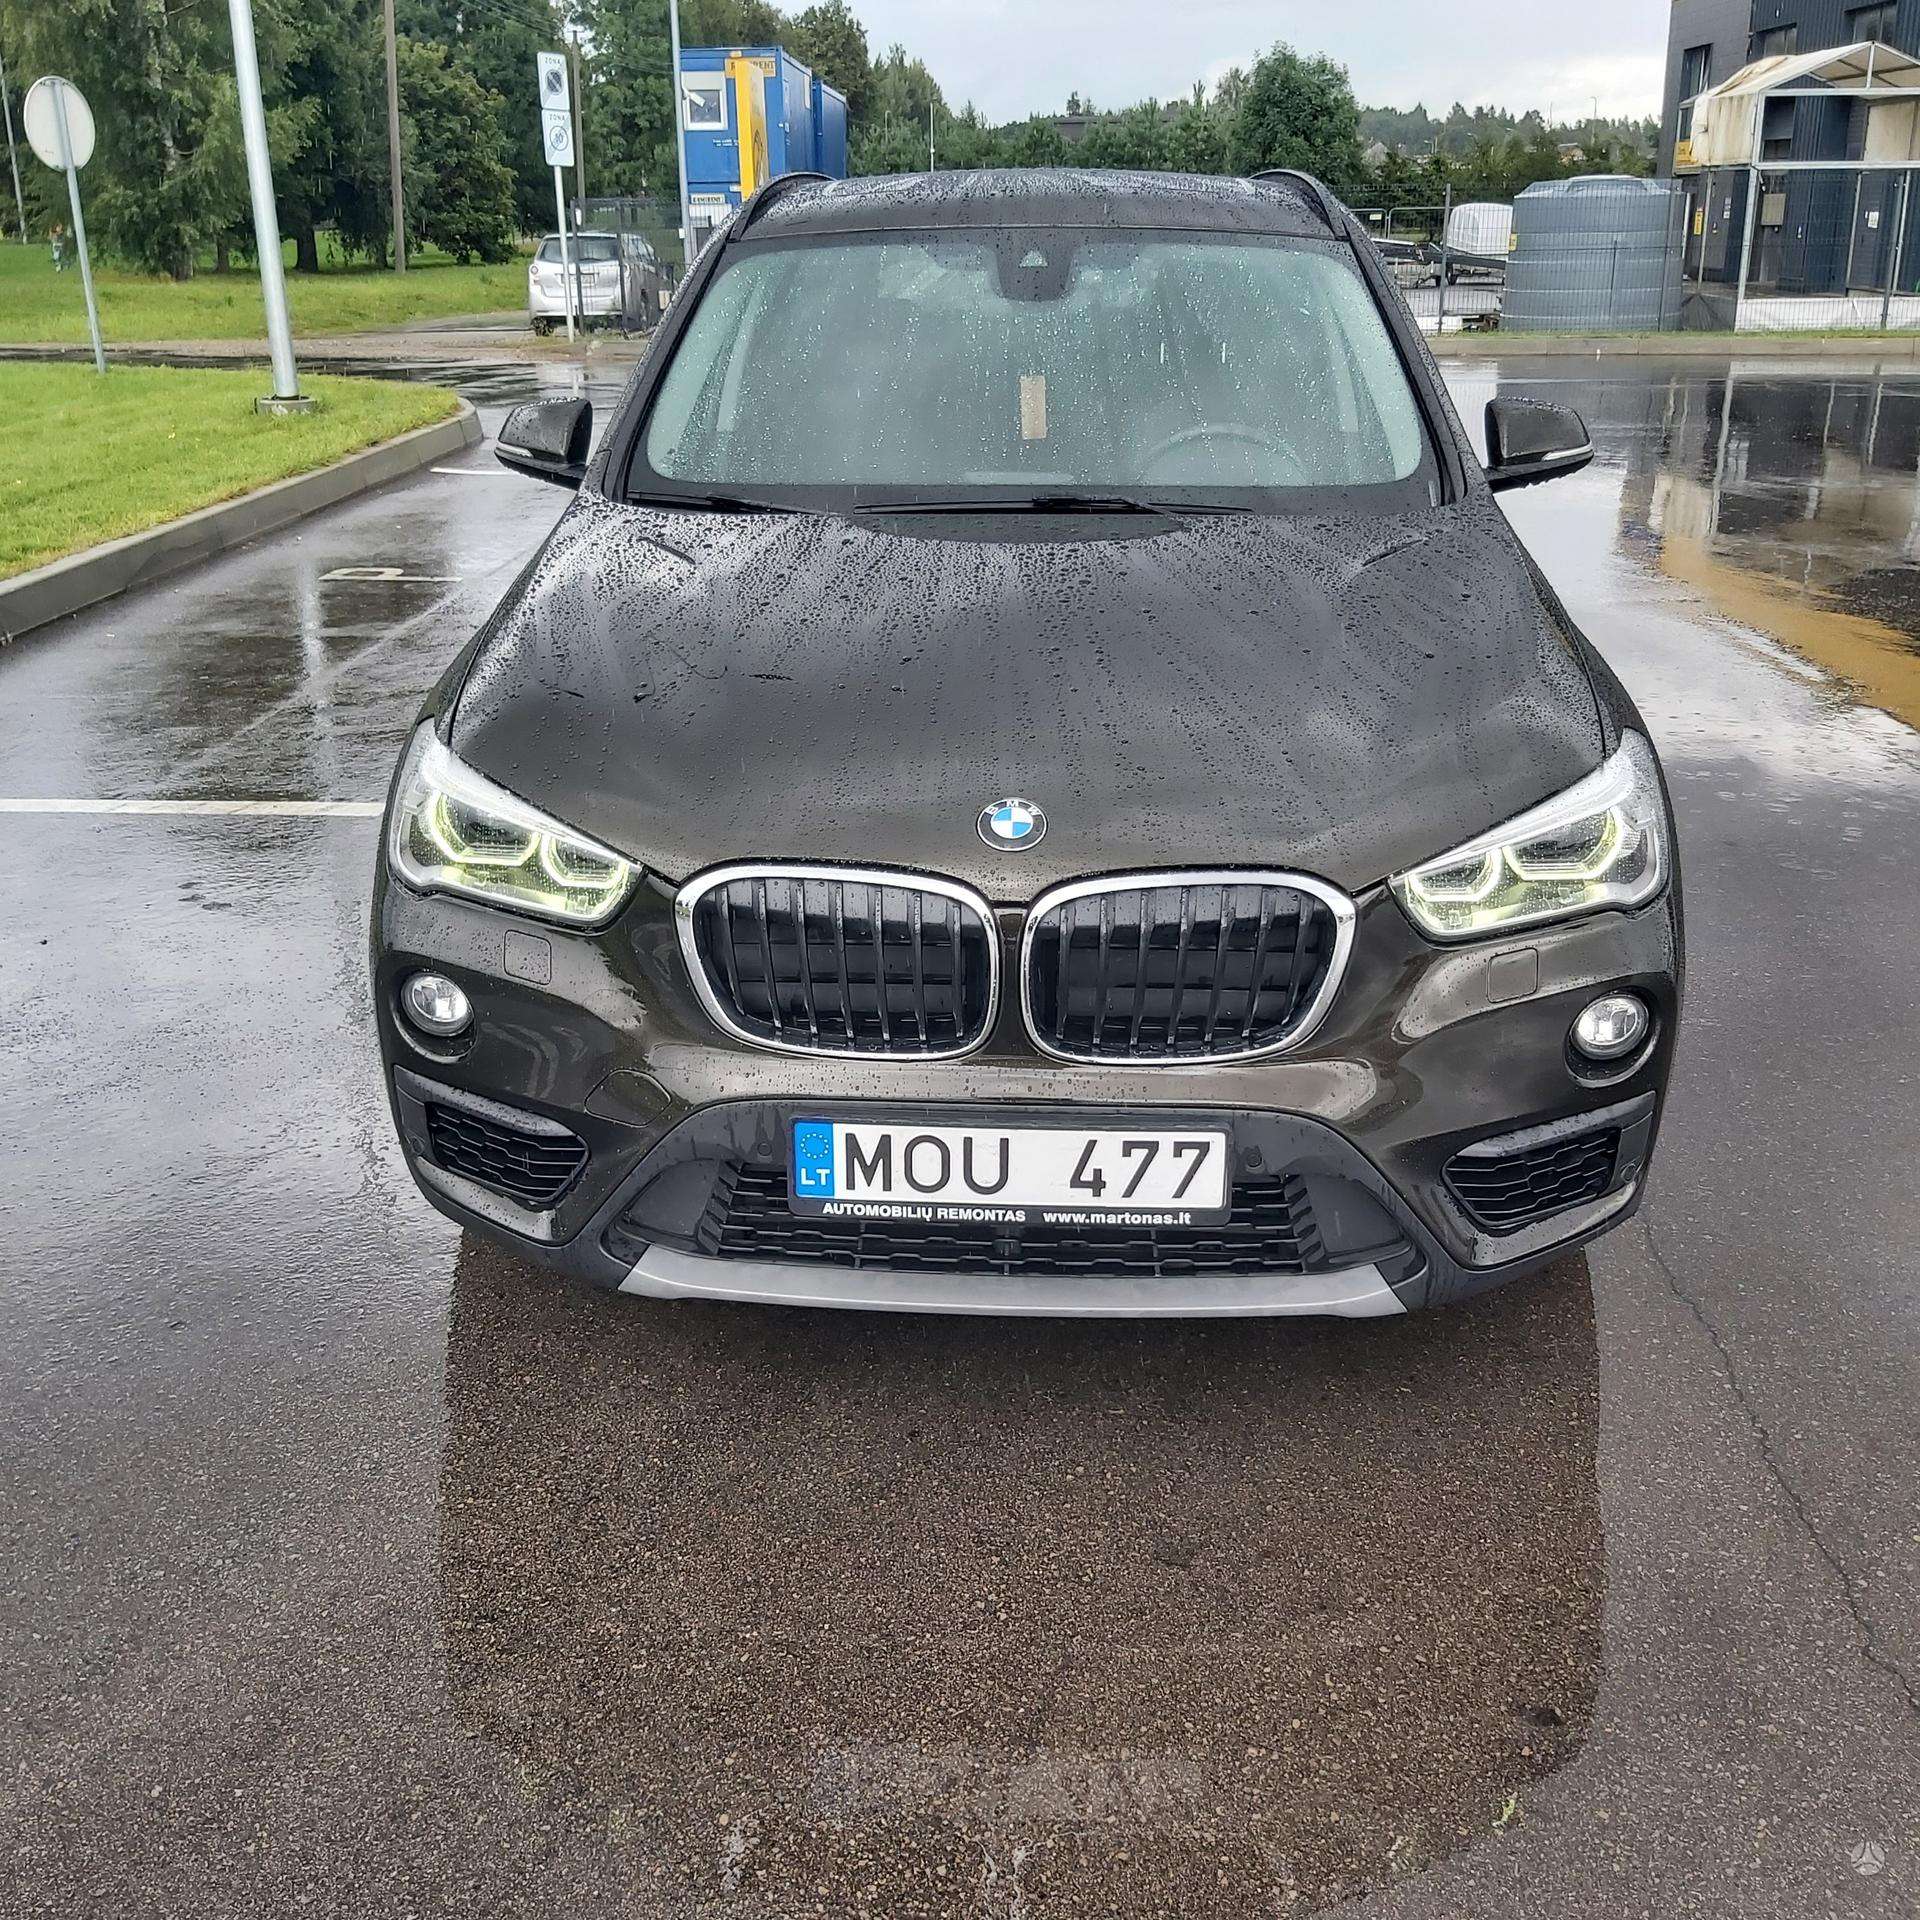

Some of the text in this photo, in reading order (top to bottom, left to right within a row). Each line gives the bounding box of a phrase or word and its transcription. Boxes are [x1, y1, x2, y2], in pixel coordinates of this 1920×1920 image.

[549, 113, 565, 121] ZONA
[984, 799, 1041, 816] BMW
[845, 1132, 1211, 1199] MOU 477
[801, 1167, 830, 1186] LT
[822, 1202, 1191, 1225] AUTOMOBILIŲ REMONTAS www.martonas.lt
